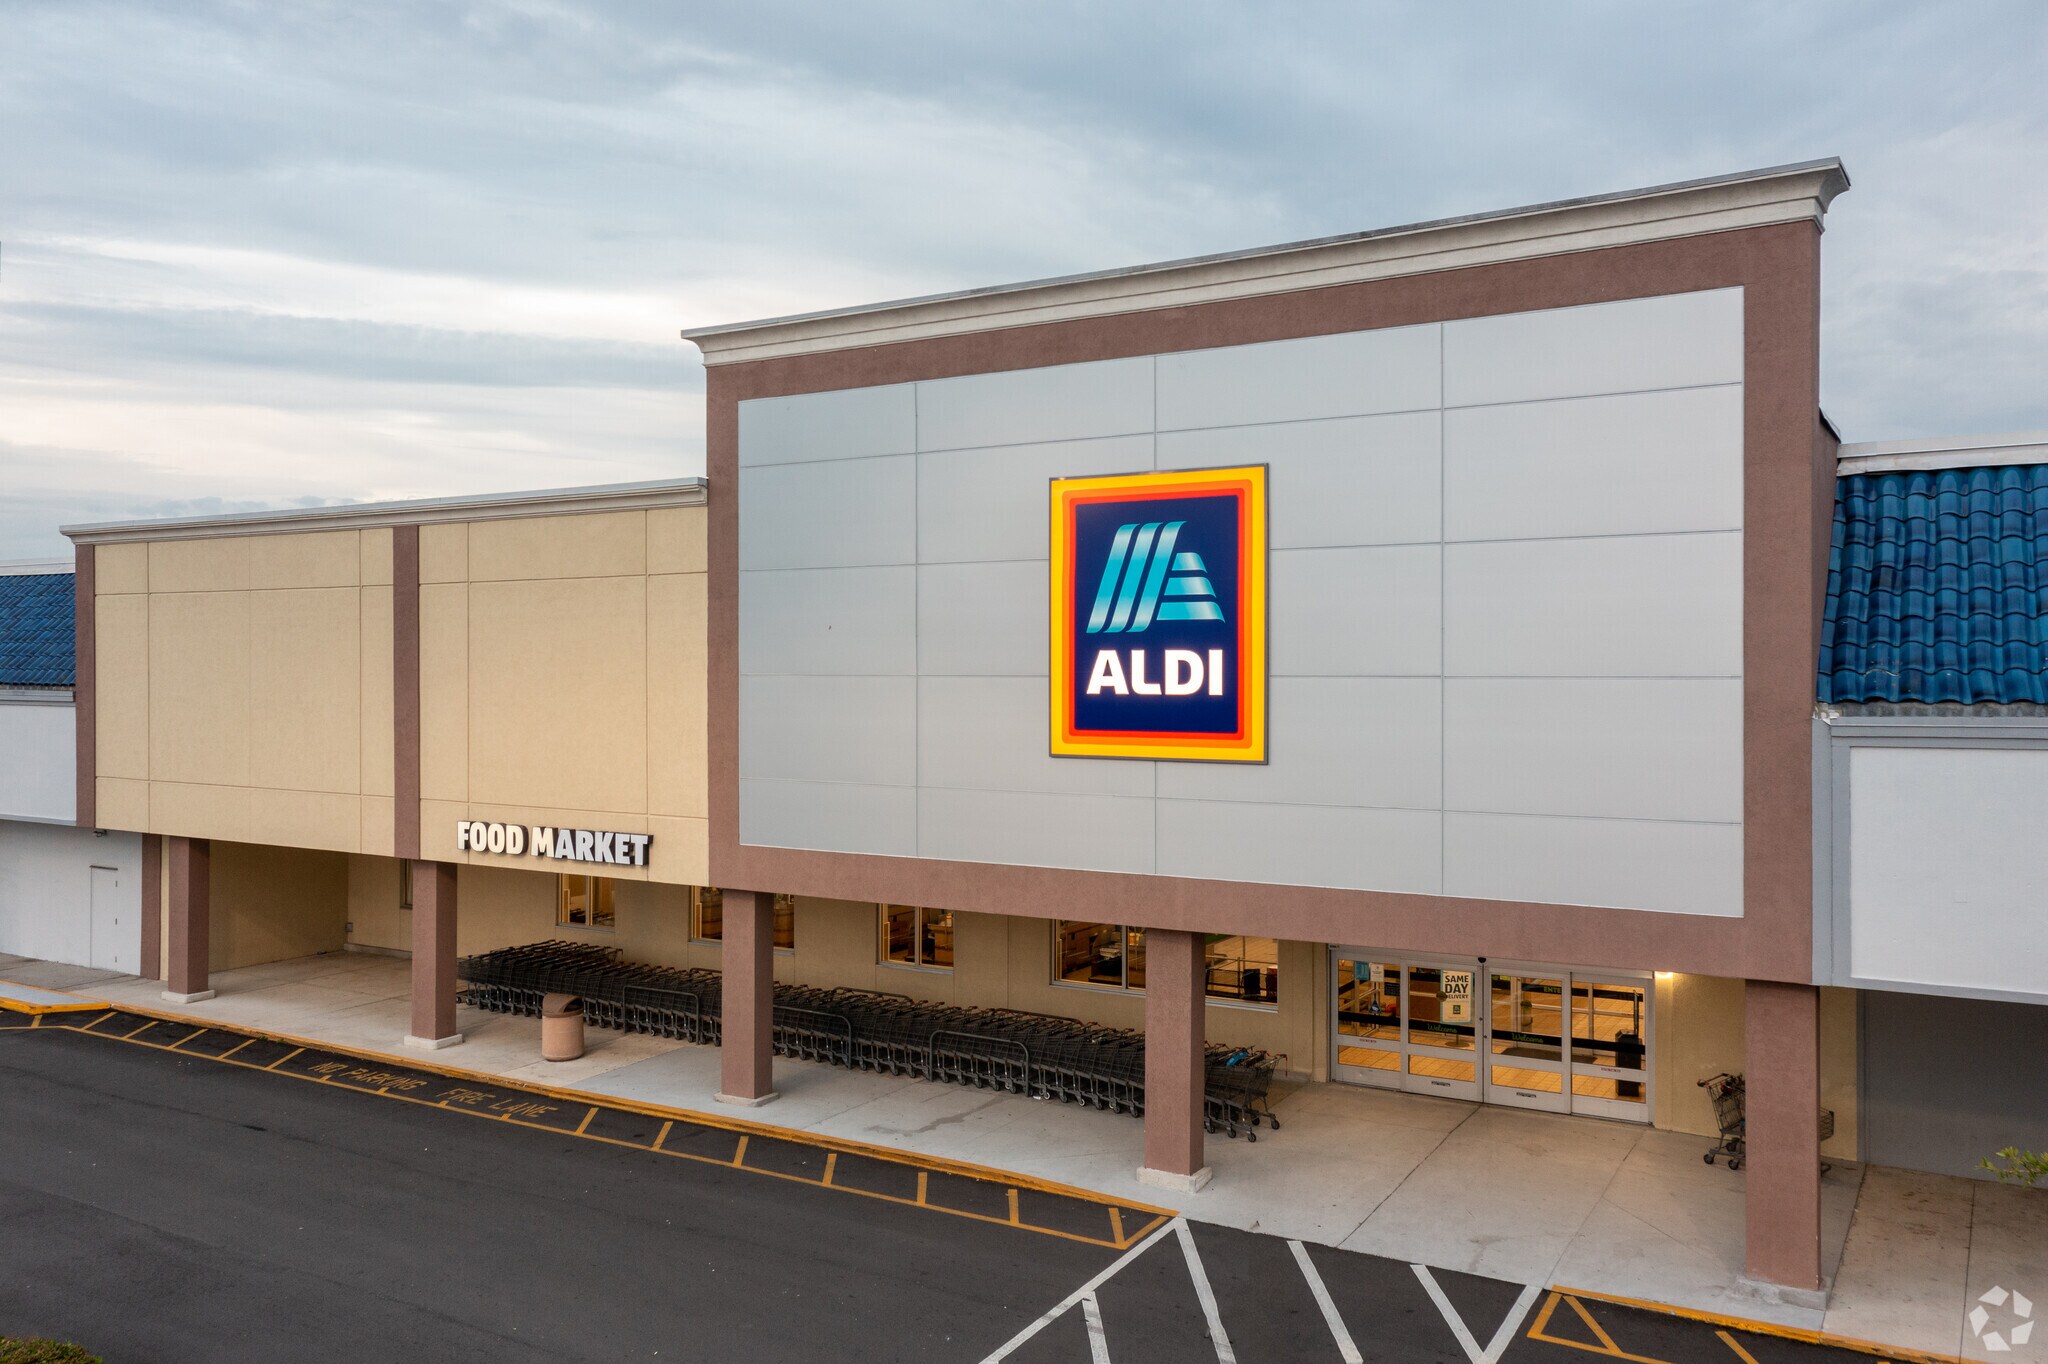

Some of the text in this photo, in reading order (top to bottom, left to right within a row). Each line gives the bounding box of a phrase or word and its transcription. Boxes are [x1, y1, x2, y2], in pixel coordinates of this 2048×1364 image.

[1086, 649, 1223, 696] ALDI
[457, 821, 651, 866] FOOD MARKET
[1445, 975, 1469, 983] SAME
[1445, 984, 1469, 993] DAY
[1427, 1023, 1458, 1034] Welcome
[1511, 1033, 1544, 1044] Welcome
[308, 1062, 559, 1118] NO PARKING FIRE LANE
